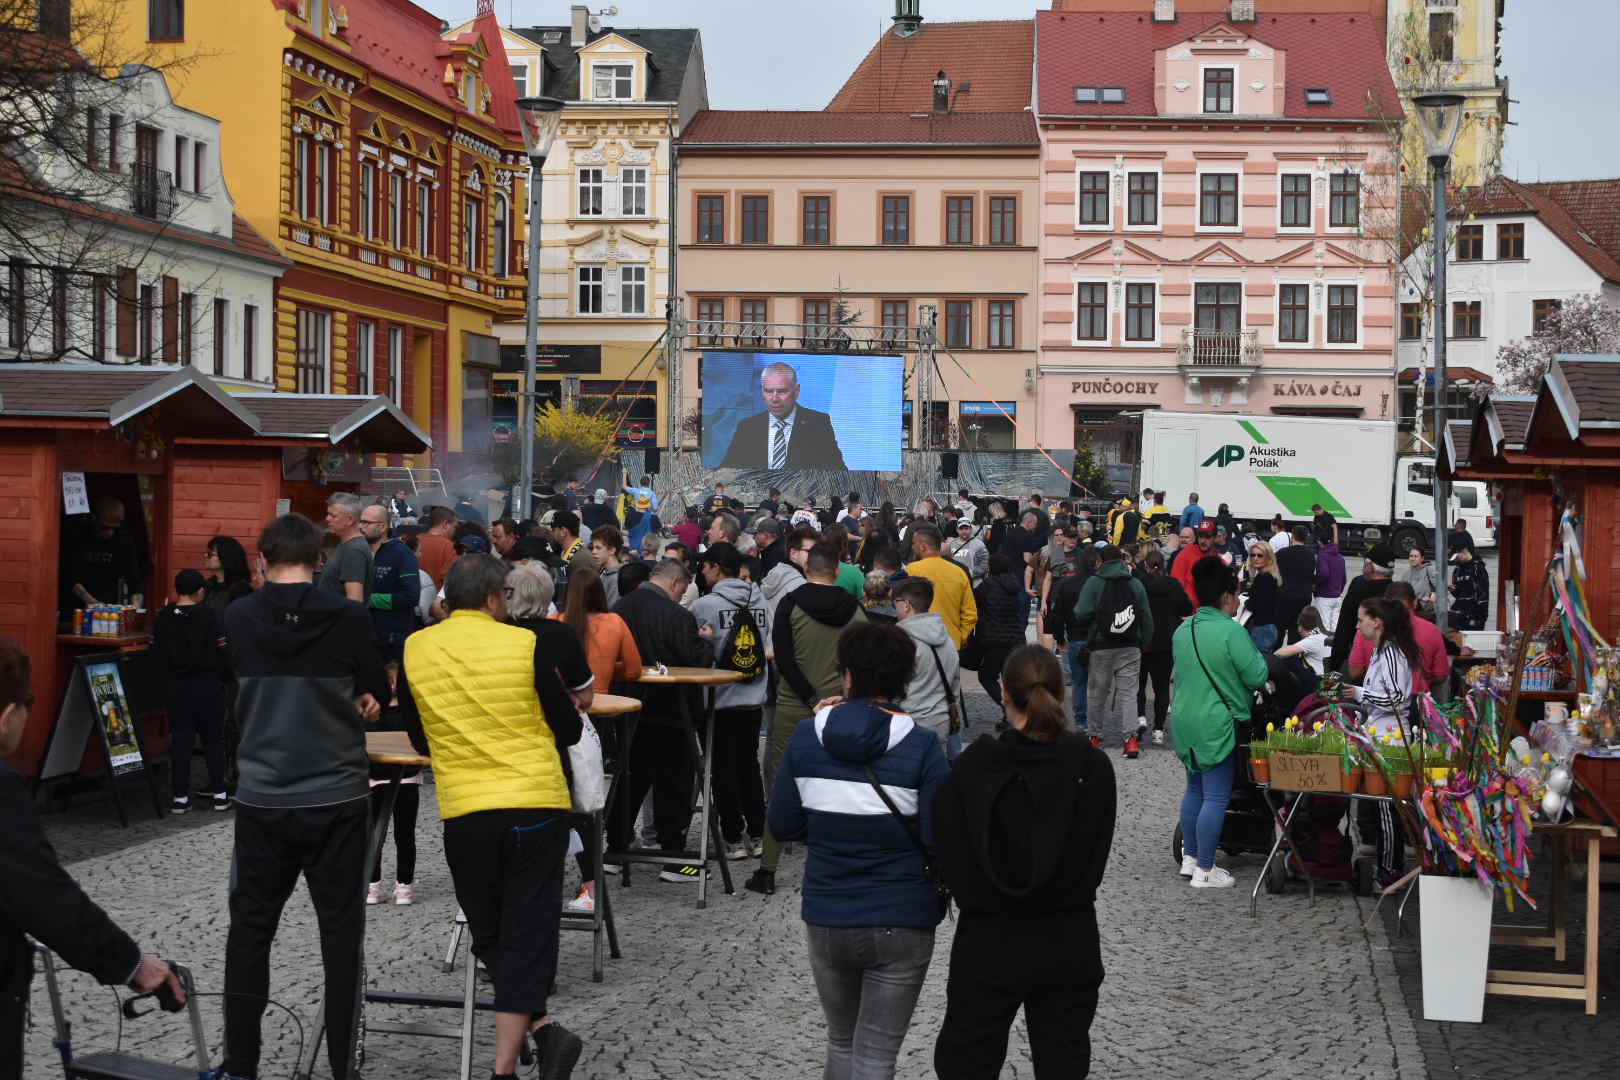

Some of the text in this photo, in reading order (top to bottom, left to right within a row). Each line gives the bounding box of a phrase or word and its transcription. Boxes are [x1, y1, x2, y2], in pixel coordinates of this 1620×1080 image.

[1071, 378, 1160, 394] PUNČOCHY
[1273, 380, 1362, 397] KÁVA ČAJ
[1200, 444, 1246, 468] AP
[1249, 446, 1297, 457] Akustika
[1249, 458, 1280, 468] Polák
[1114, 604, 1134, 627] NIKE
